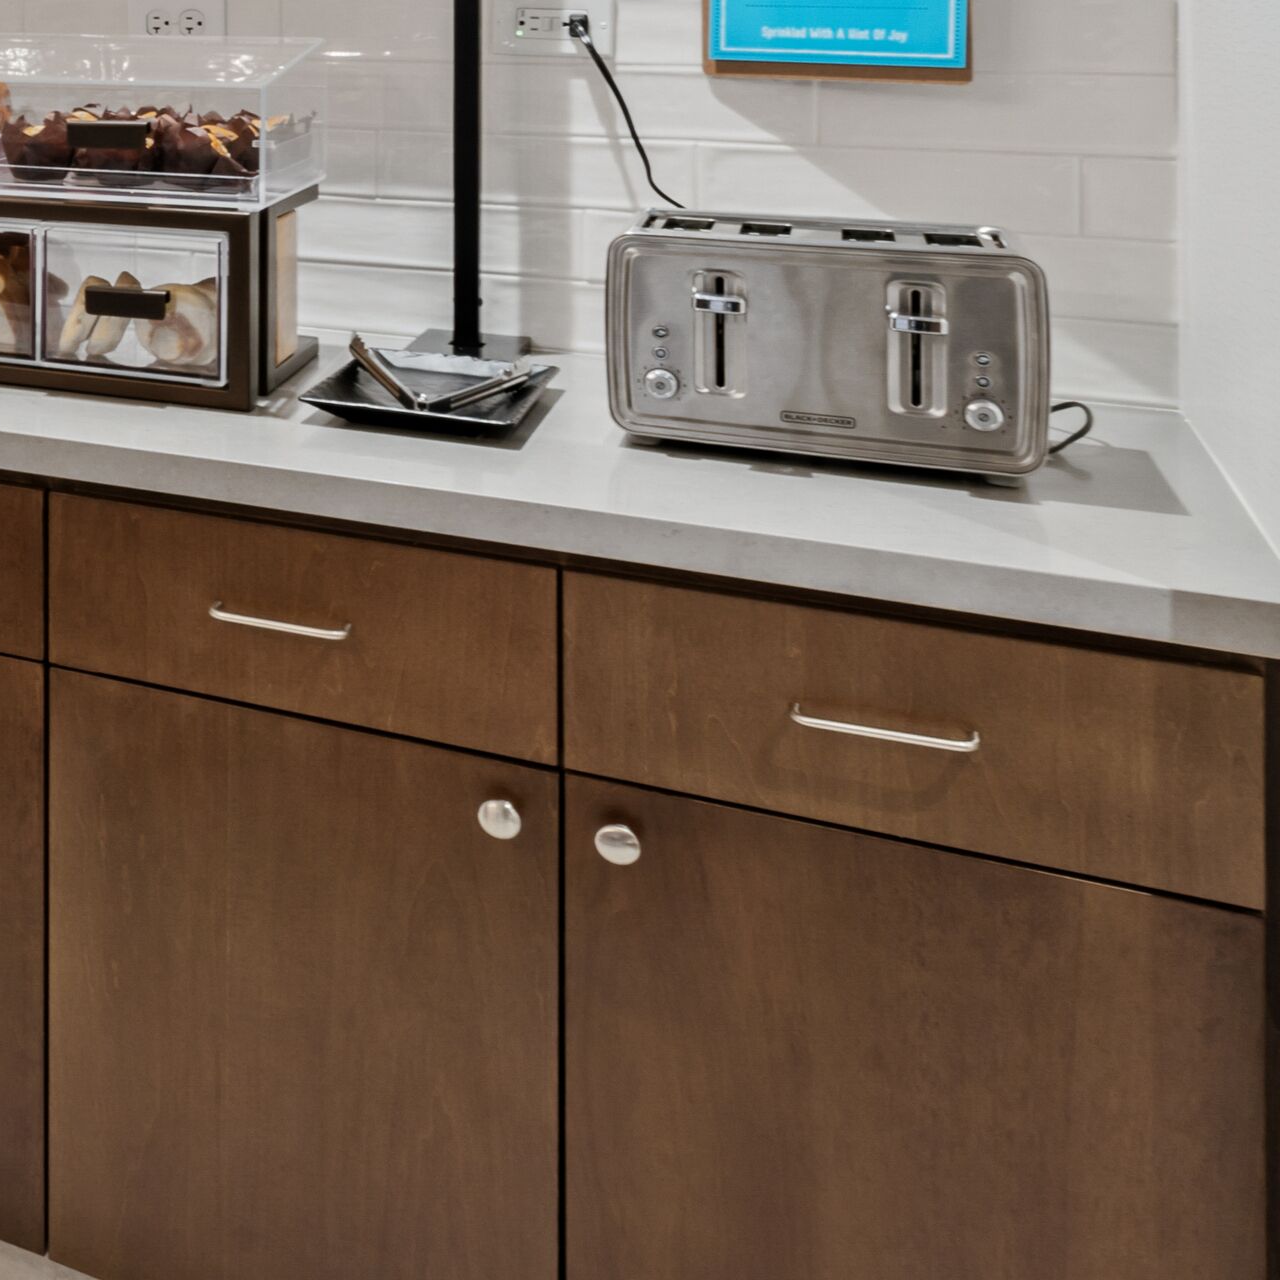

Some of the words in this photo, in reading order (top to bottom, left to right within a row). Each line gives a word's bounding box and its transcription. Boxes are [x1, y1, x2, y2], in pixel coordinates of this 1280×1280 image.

[761, 26, 807, 40] Sprinkled
[810, 27, 834, 39] With
[836, 27, 846, 39] A
[848, 28, 870, 40] Hint
[873, 28, 886, 40] Of
[888, 30, 909, 43] Joy
